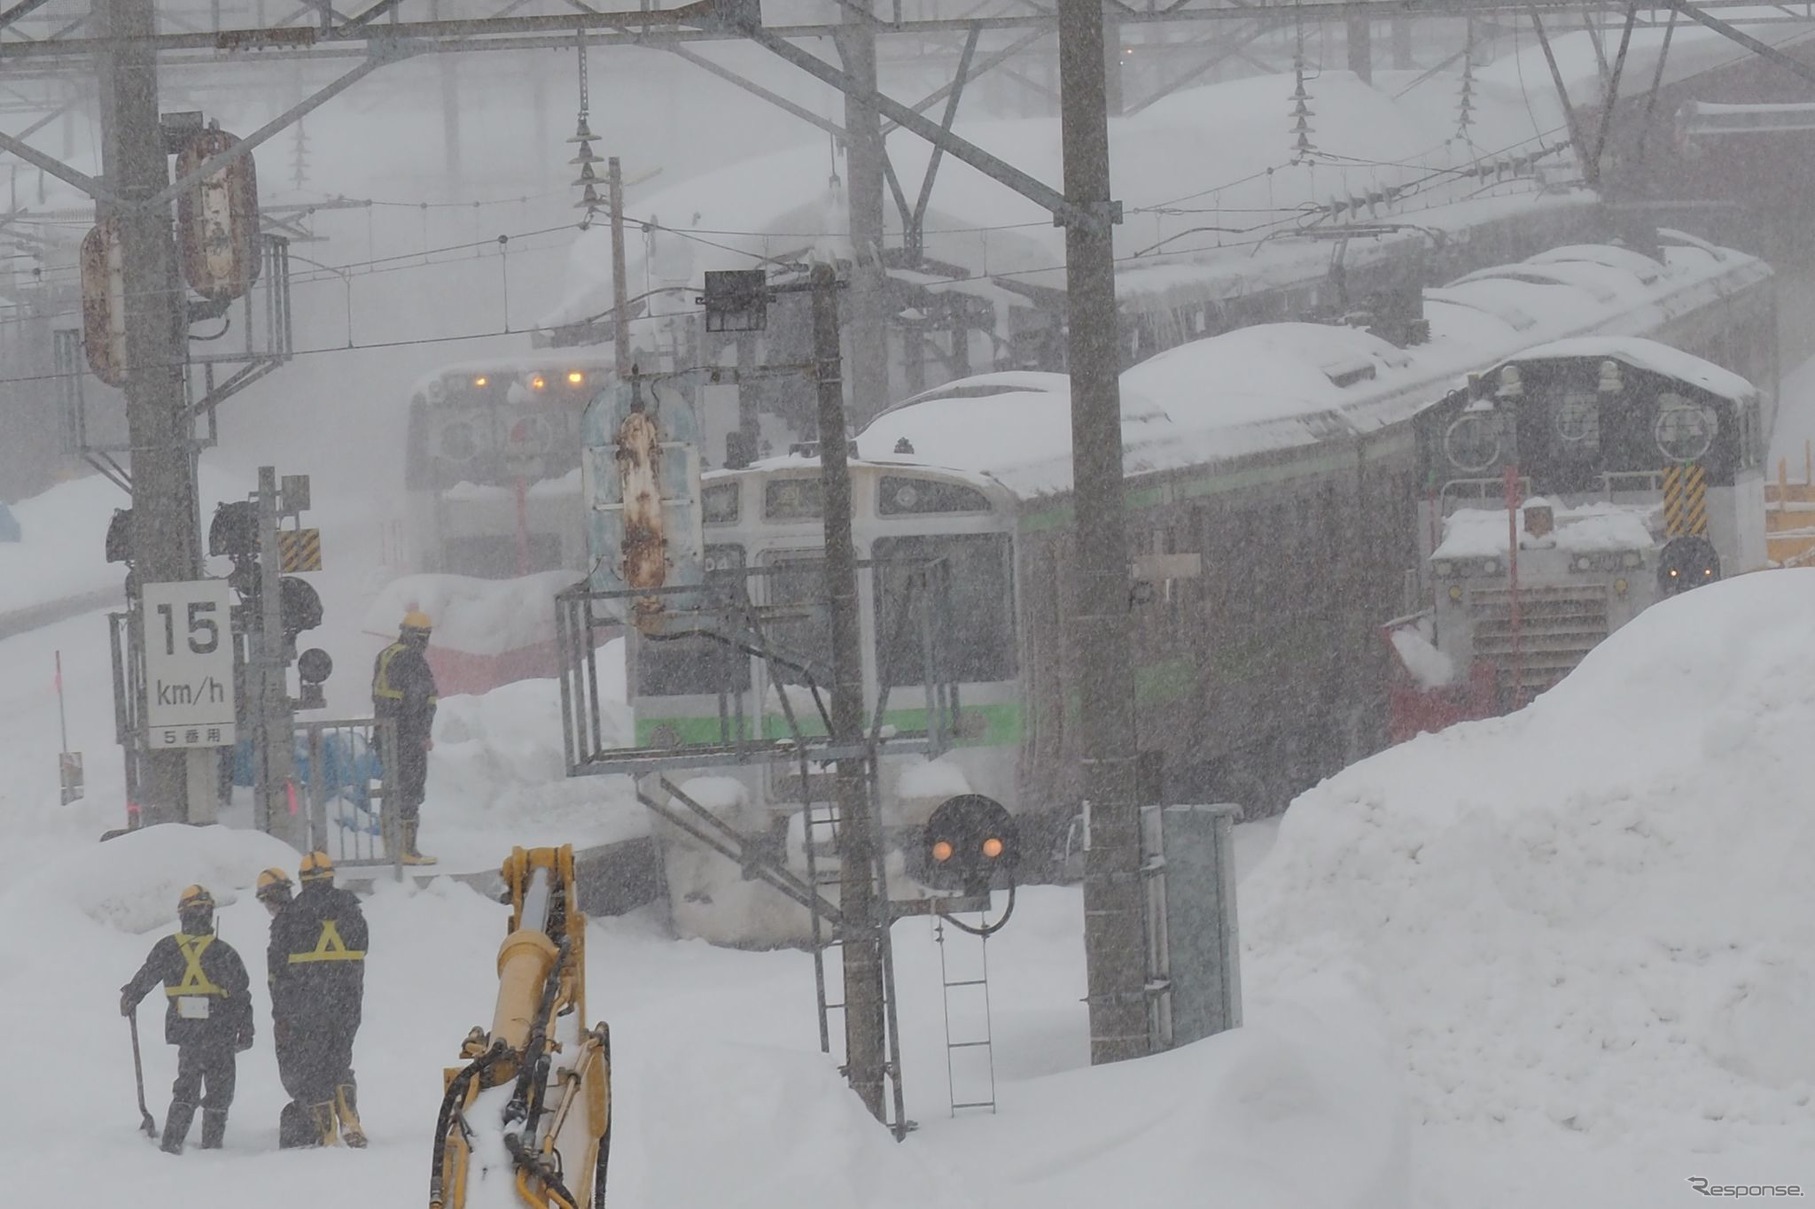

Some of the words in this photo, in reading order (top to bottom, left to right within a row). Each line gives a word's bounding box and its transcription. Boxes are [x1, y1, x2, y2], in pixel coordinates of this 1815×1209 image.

[157, 602, 219, 655] 15
[157, 676, 224, 706] km/h
[164, 728, 221, 744] 5番用
